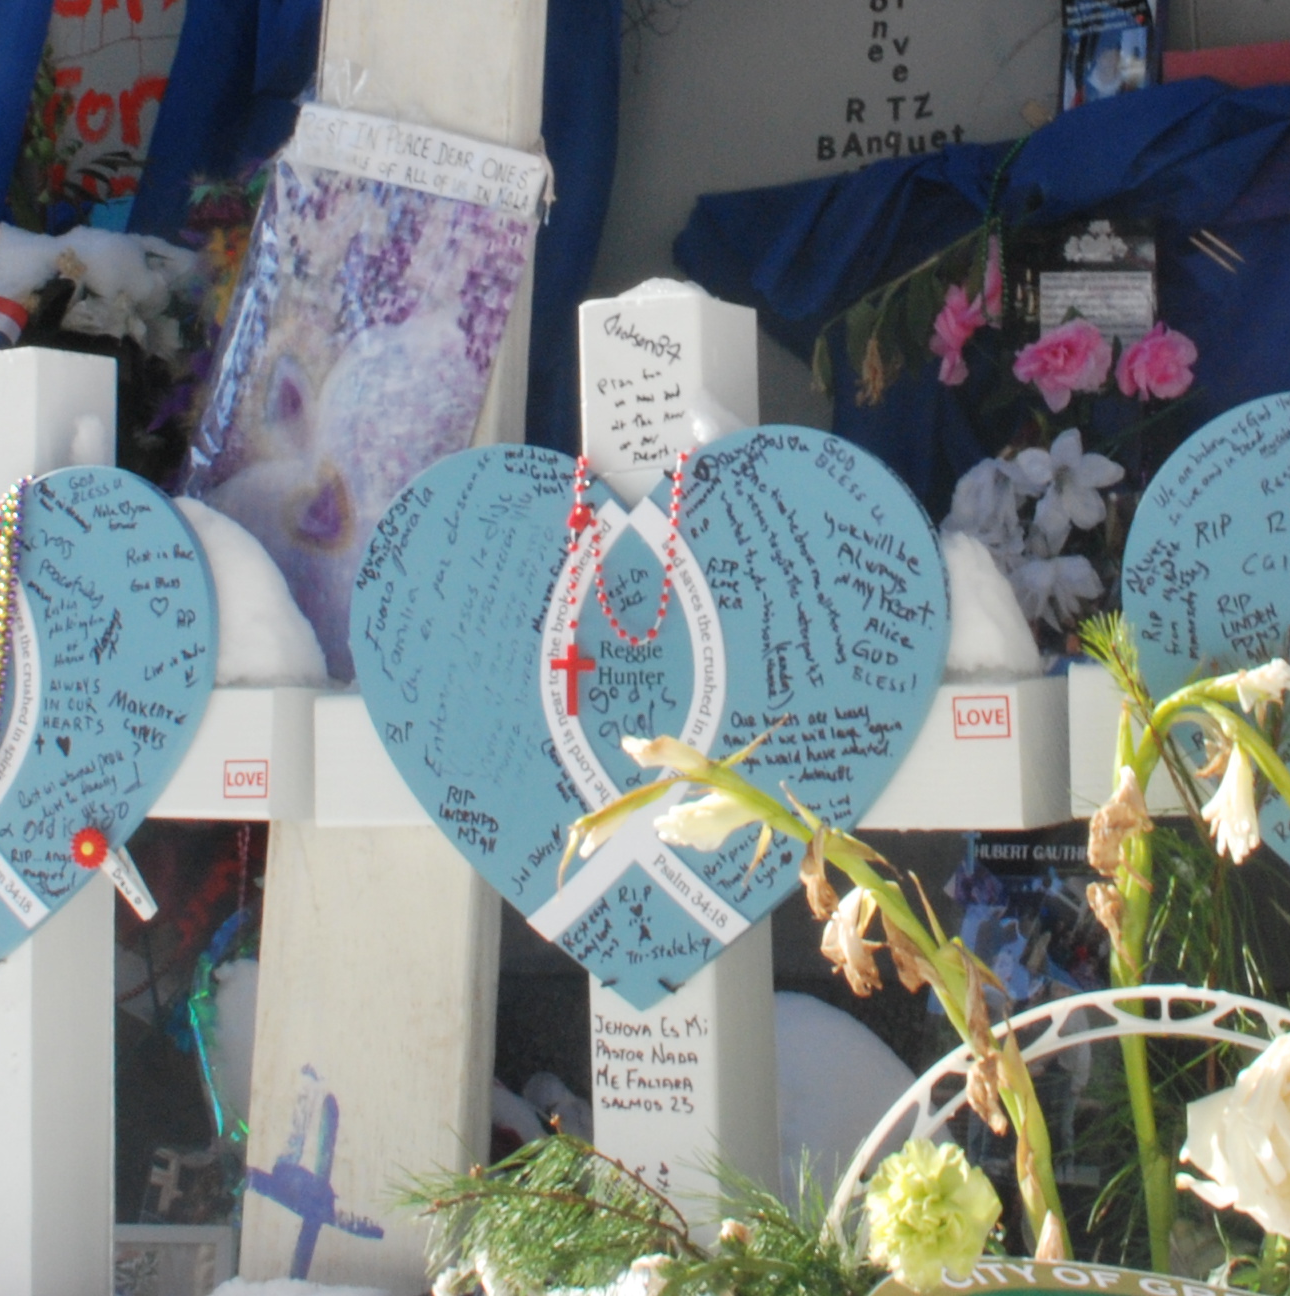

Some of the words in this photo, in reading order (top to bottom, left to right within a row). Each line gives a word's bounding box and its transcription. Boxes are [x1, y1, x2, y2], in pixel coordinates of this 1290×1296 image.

[386, 123, 431, 160] PEACE
[433, 138, 477, 173] DEAR
[482, 156, 530, 192] ONES
[404, 165, 429, 186] ALL
[476, 186, 490, 203] IN
[1194, 513, 1233, 549] RIP
[895, 538, 922, 577] be
[676, 564, 698, 610] saves
[1217, 593, 1252, 616] RIP
[696, 614, 711, 636] the
[864, 617, 915, 650] Alice
[15, 632, 33, 660] the
[599, 640, 664, 664] Reggie
[49, 678, 102, 696] ALWAYS
[598, 665, 666, 686] Hunter
[702, 641, 718, 711] crushed
[17, 660, 36, 726] crushed
[43, 697, 65, 713] IN
[42, 715, 105, 734] HEARTS
[697, 713, 711, 736] in
[957, 708, 1006, 726] LOVE
[6, 728, 21, 748] in
[227, 772, 265, 787] LOVE
[446, 784, 477, 805] RIP
[974, 844, 1030, 861] HUBERT
[1, 878, 35, 917] 34:18
[652, 851, 696, 897] Psalm
[690, 891, 729, 930] 34:18
[593, 1014, 652, 1038] JEHOVA
[593, 1038, 645, 1062] PASTOR
[650, 1041, 699, 1064] NADA
[595, 1063, 621, 1090] ME
[940, 1262, 1037, 1289] CITY
[1052, 1265, 1122, 1288] OF
